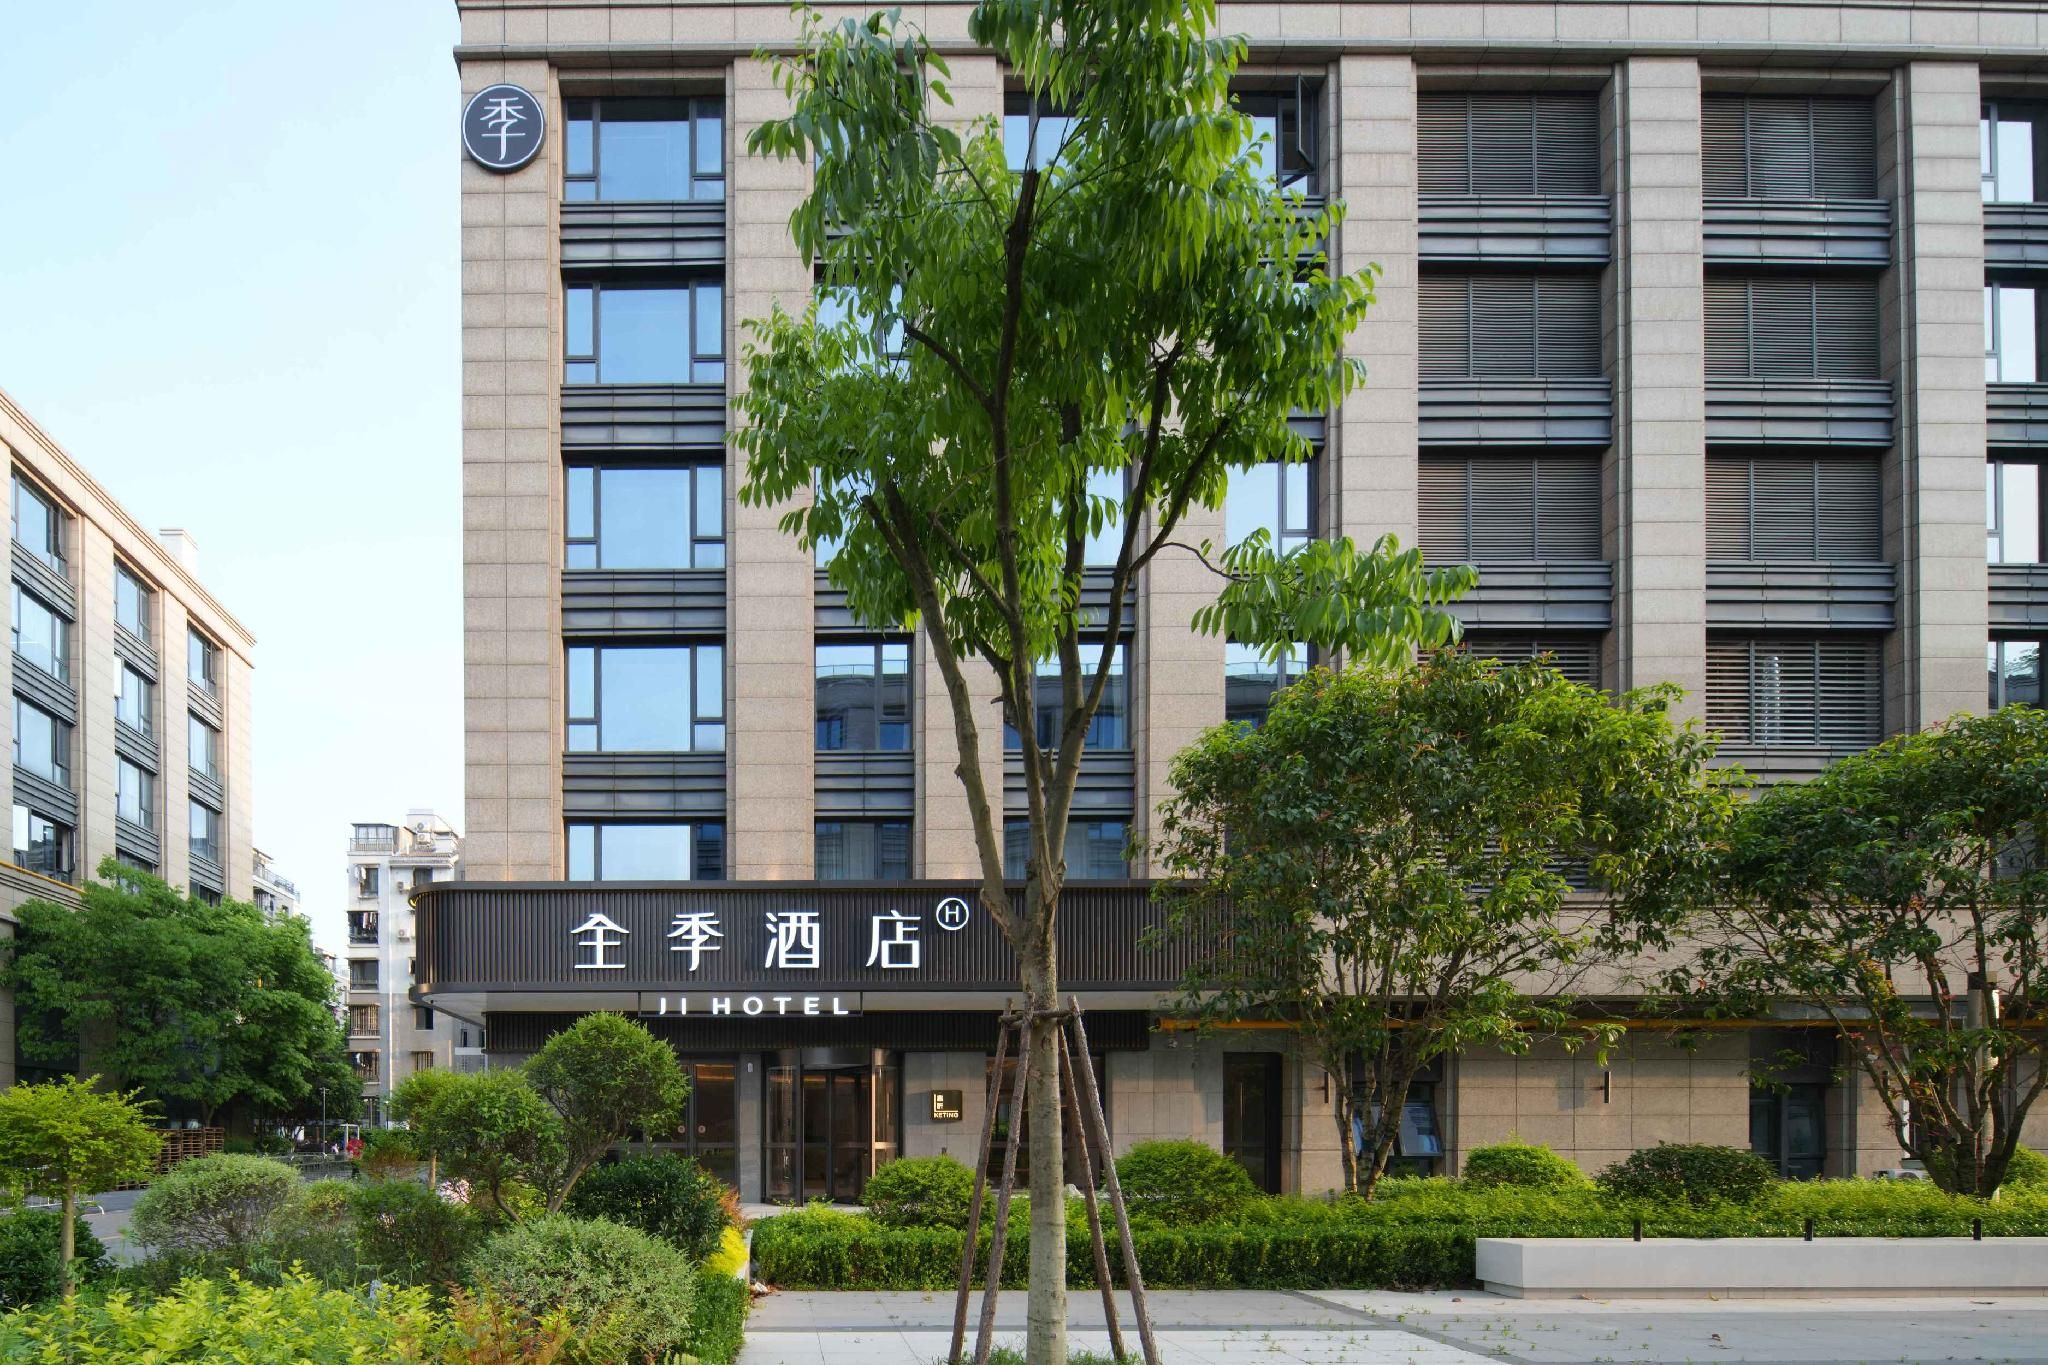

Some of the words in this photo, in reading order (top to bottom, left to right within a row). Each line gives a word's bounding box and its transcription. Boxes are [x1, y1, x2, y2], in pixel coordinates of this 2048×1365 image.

[480, 97, 527, 160] 季
[571, 909, 921, 971] 全季酒店
[659, 997, 687, 1015] JI
[712, 996, 849, 1015] HOTEL
